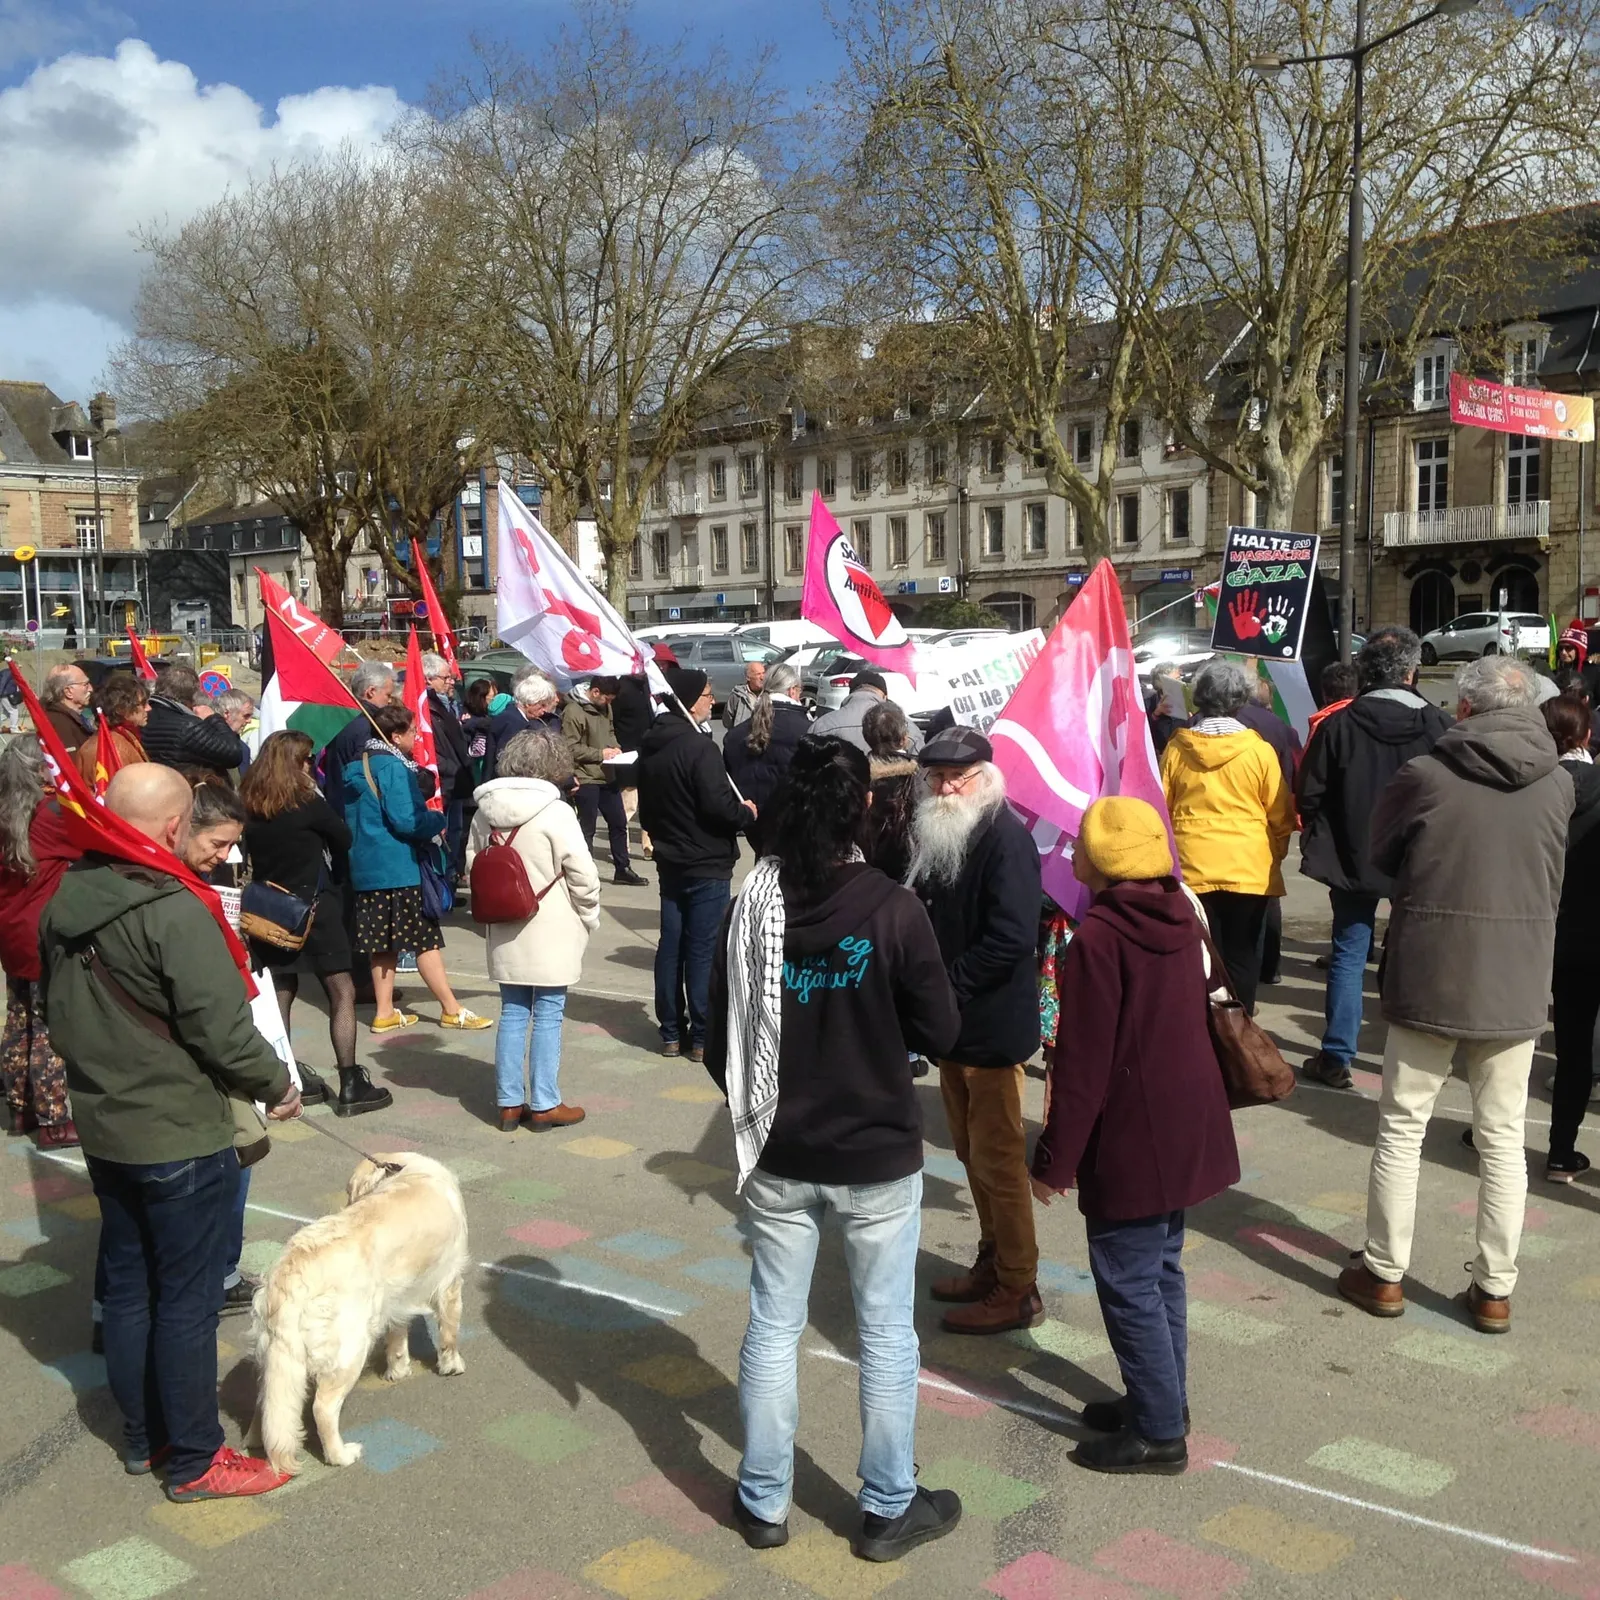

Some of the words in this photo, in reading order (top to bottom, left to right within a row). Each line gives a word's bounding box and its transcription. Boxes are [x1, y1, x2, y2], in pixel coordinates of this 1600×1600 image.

[1232, 533, 1292, 552] HALTE
[1292, 538, 1312, 550] AU
[1230, 549, 1312, 562] MASSACRE
[1226, 562, 1307, 587] GAZA
